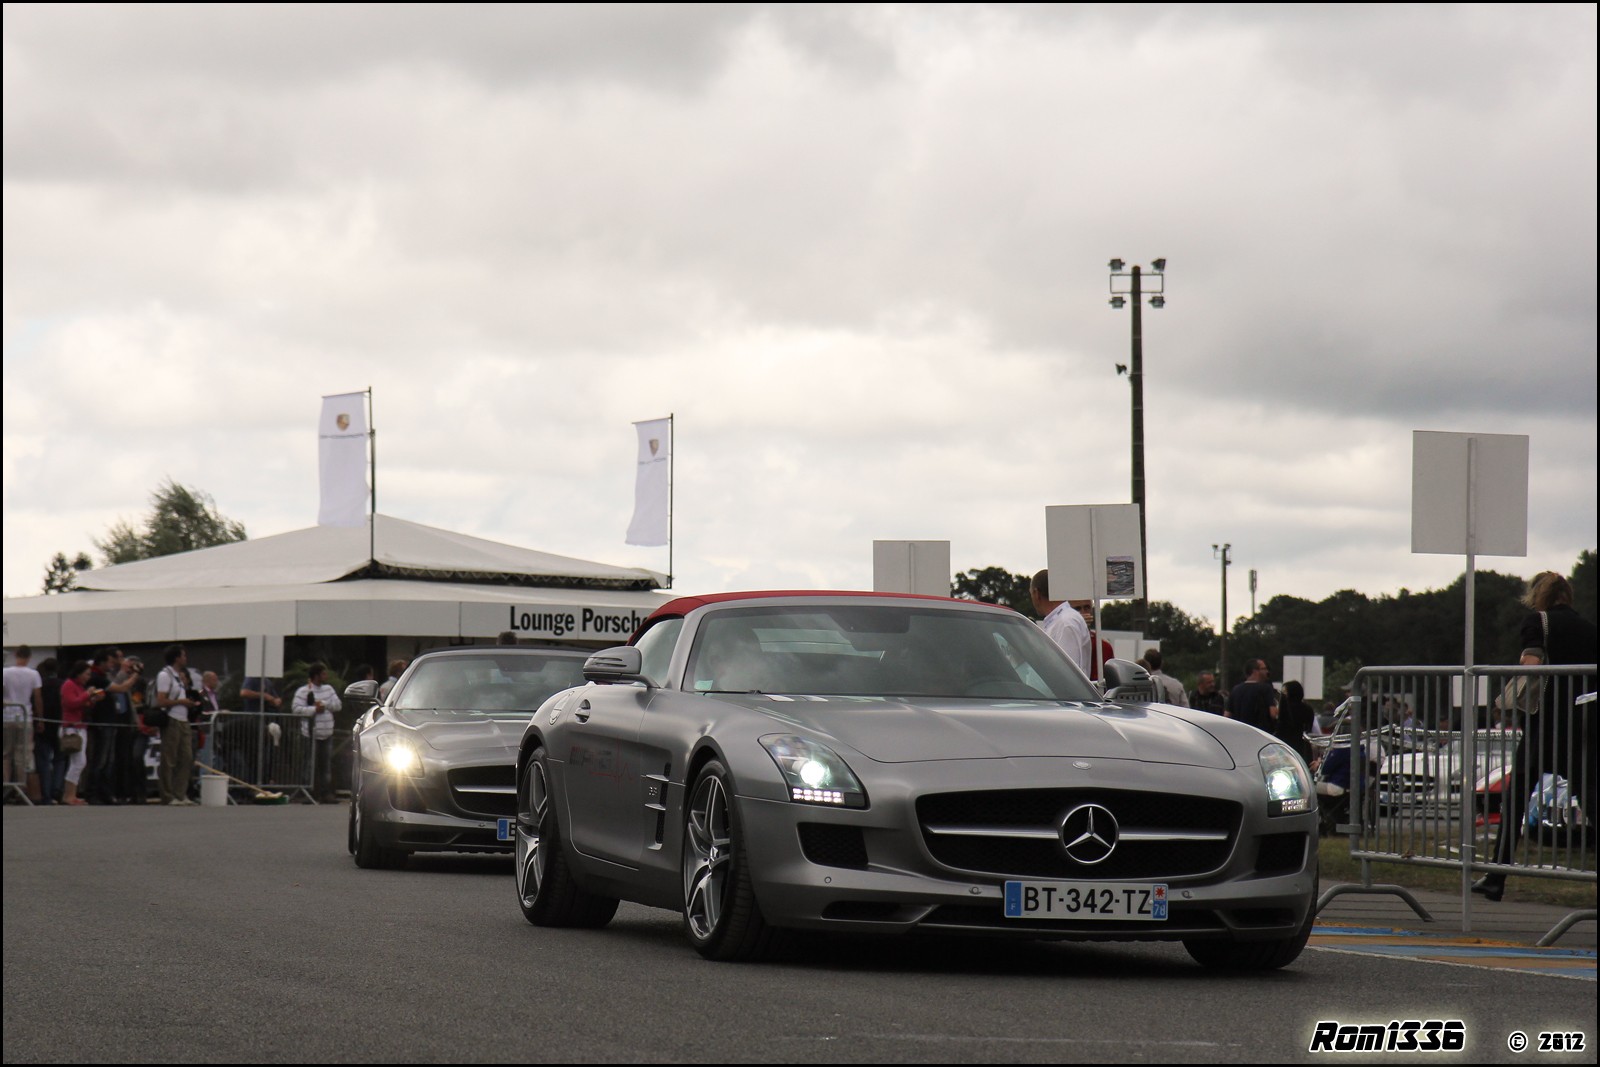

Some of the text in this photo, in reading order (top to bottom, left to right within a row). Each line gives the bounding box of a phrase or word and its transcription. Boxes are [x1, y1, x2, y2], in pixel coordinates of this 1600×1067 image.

[510, 605, 575, 636] Lounge
[1023, 886, 1152, 915] BT-342-TZ
[1153, 903, 1166, 917] 78
